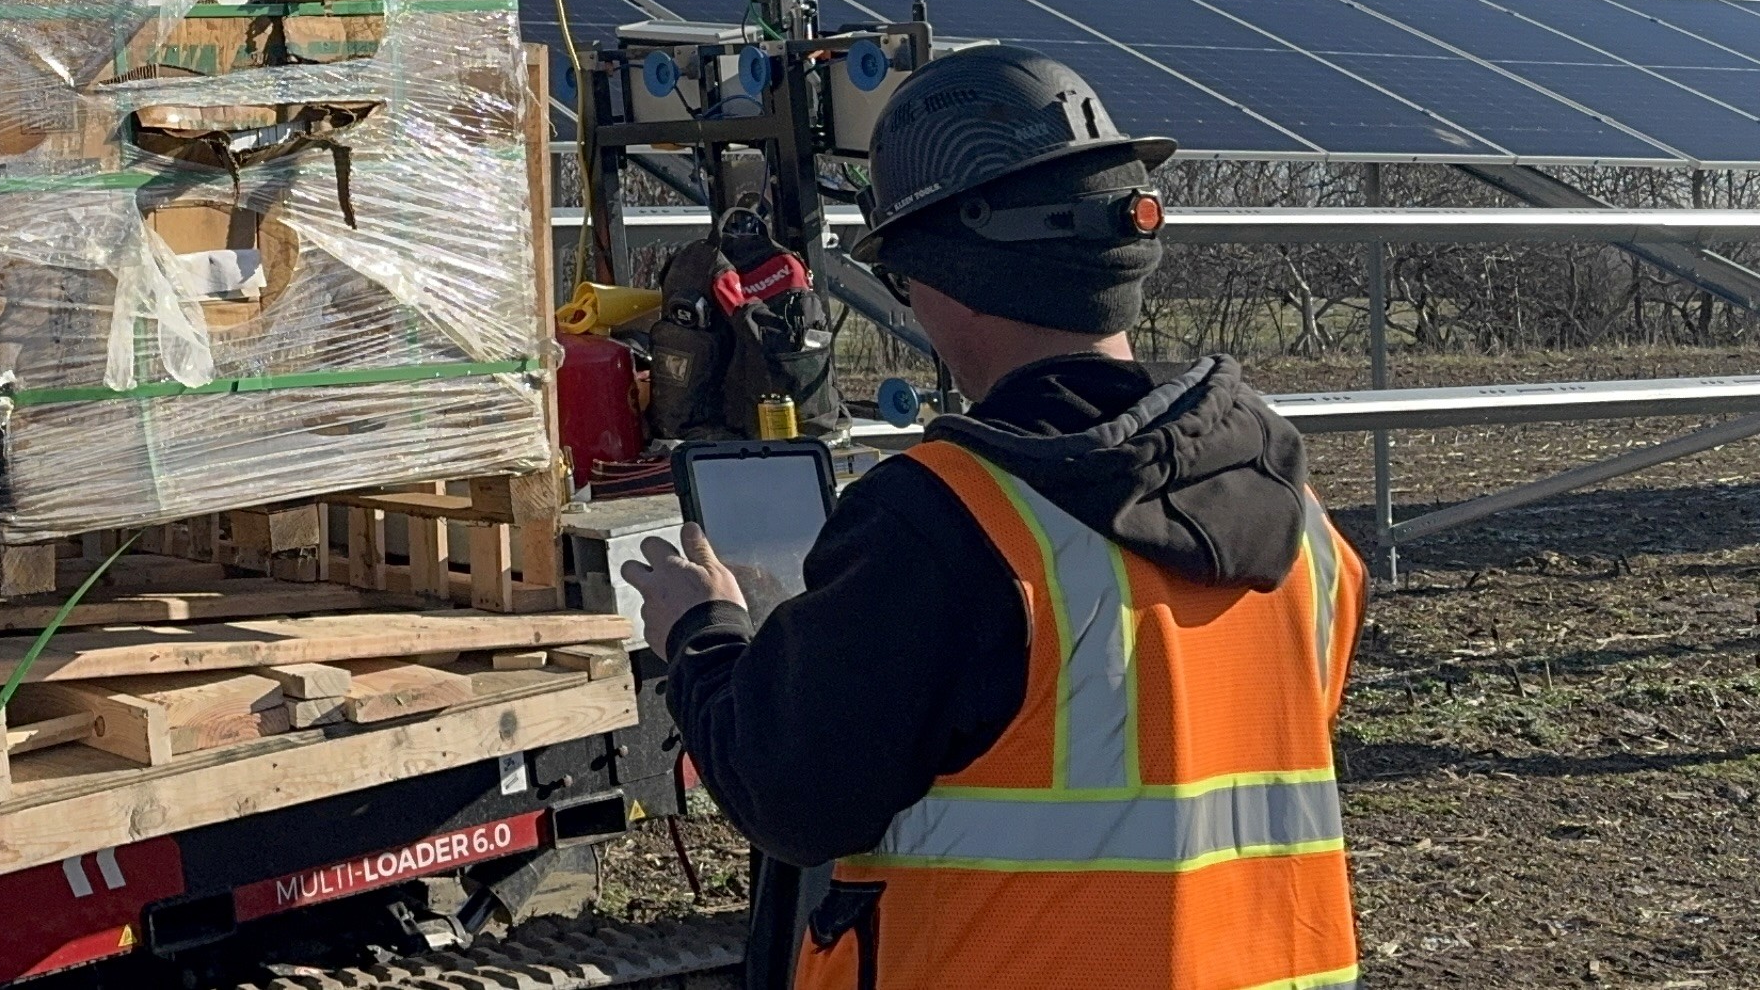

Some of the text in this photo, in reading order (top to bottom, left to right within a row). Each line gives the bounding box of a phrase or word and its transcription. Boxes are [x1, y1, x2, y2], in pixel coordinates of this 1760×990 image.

[743, 264, 792, 295] HUSKY
[275, 823, 511, 906] MULTI-LOADER 6.0
